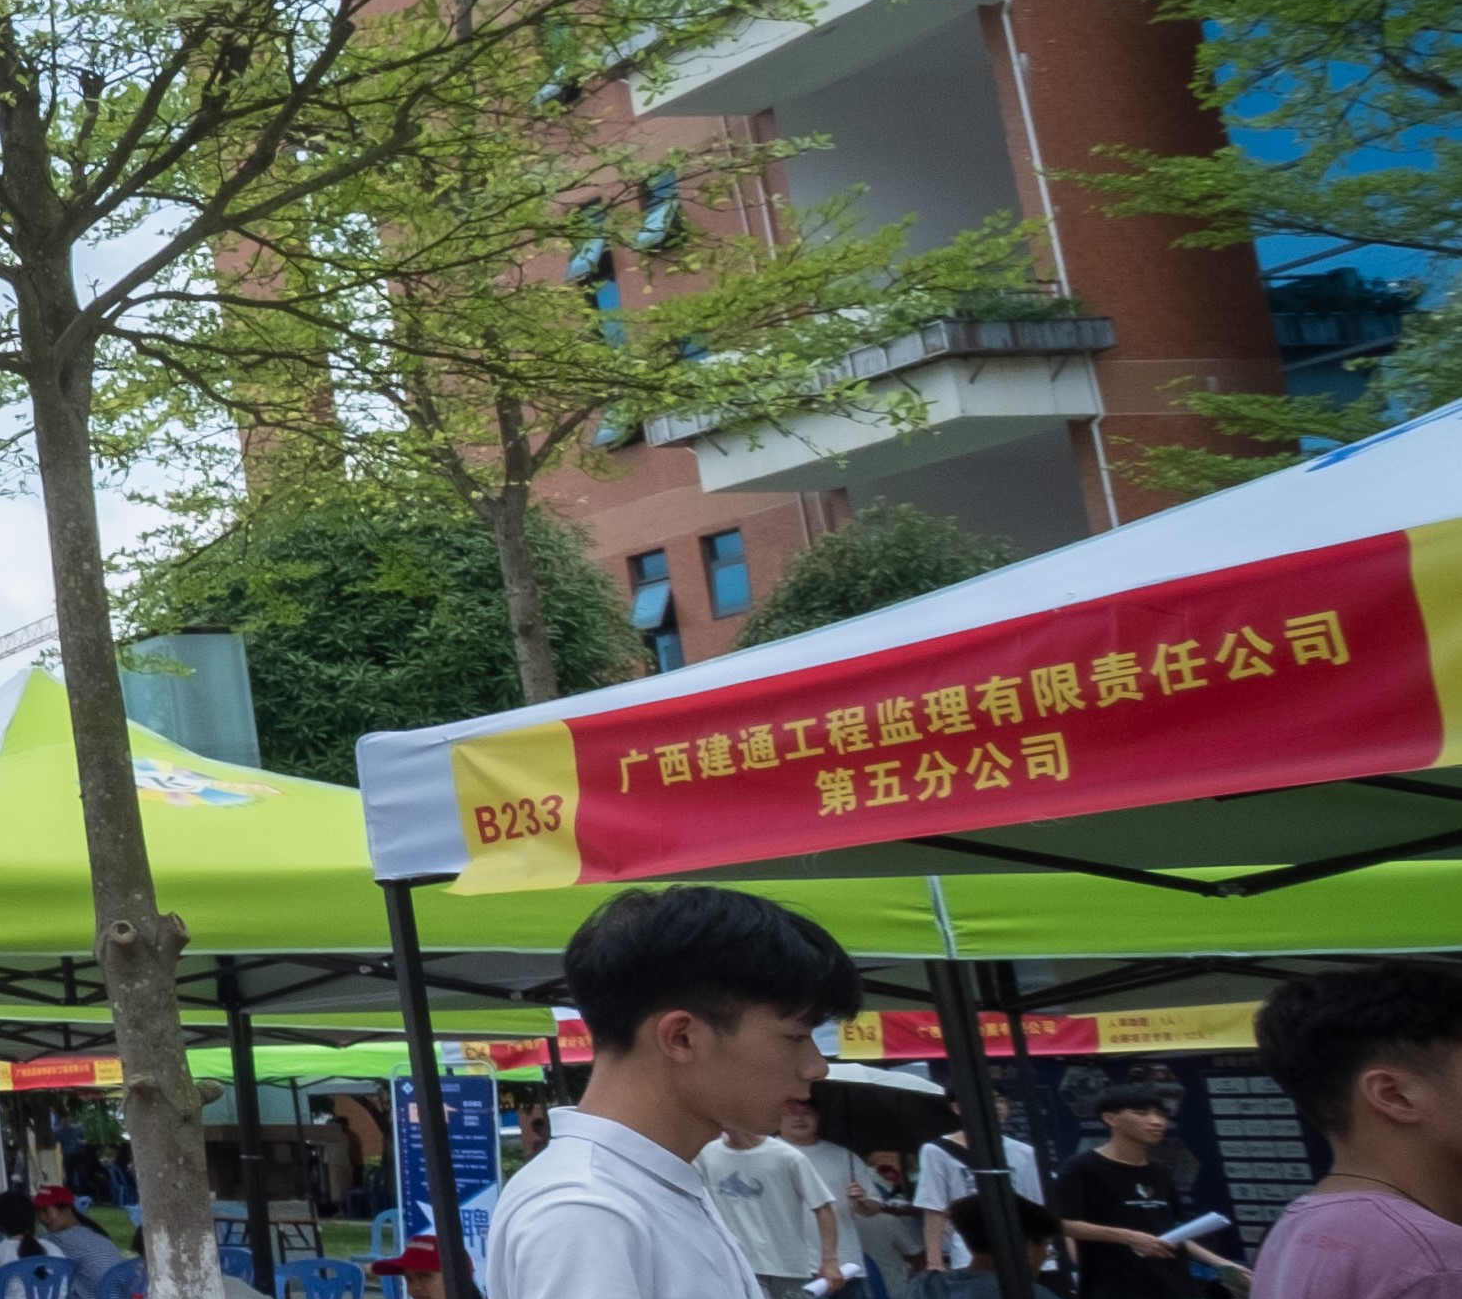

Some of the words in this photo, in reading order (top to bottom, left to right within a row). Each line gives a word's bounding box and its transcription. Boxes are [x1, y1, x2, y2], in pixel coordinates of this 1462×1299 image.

[619, 610, 1352, 794] 广西建通工程监理有限责任公司
[814, 731, 1073, 817] 第五分公司
[474, 794, 563, 846] B233
[844, 1022, 876, 1042] E13
